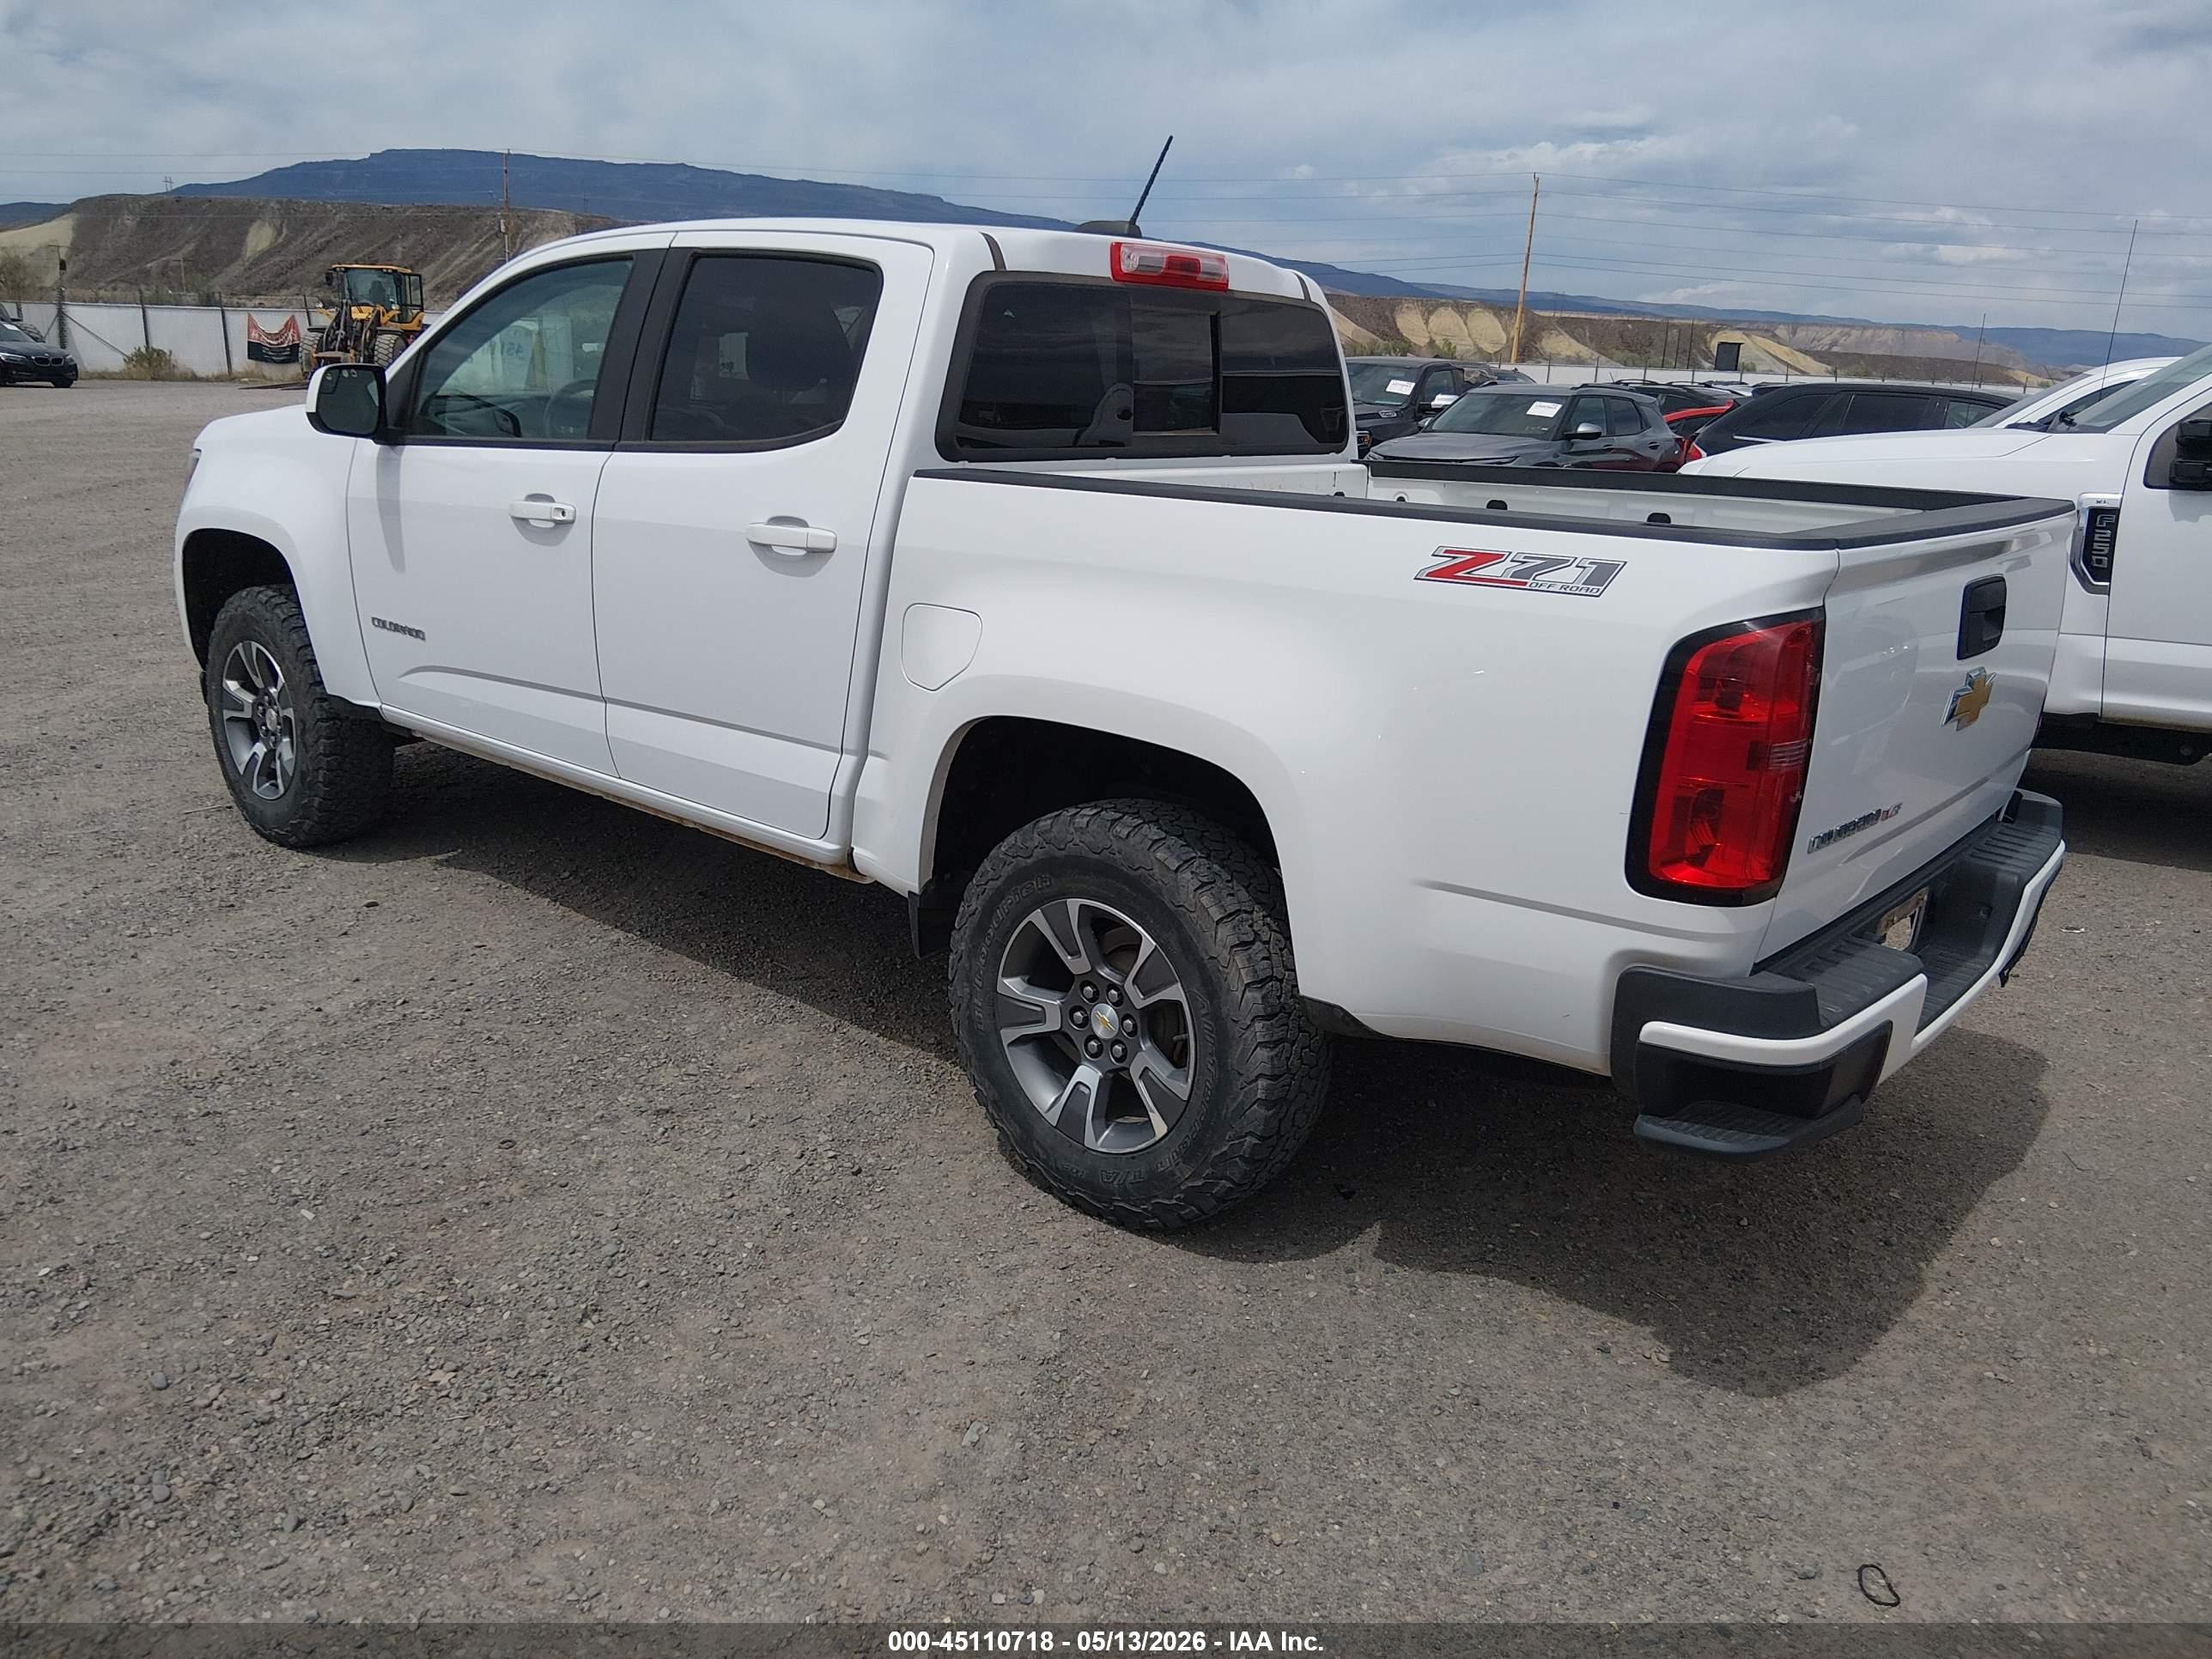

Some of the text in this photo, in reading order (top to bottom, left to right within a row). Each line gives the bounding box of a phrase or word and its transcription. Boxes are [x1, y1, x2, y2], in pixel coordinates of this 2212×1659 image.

[2091, 514, 2116, 568] F250
[1413, 544, 1627, 593] Z71
[1528, 580, 1601, 595] OFF ROAD
